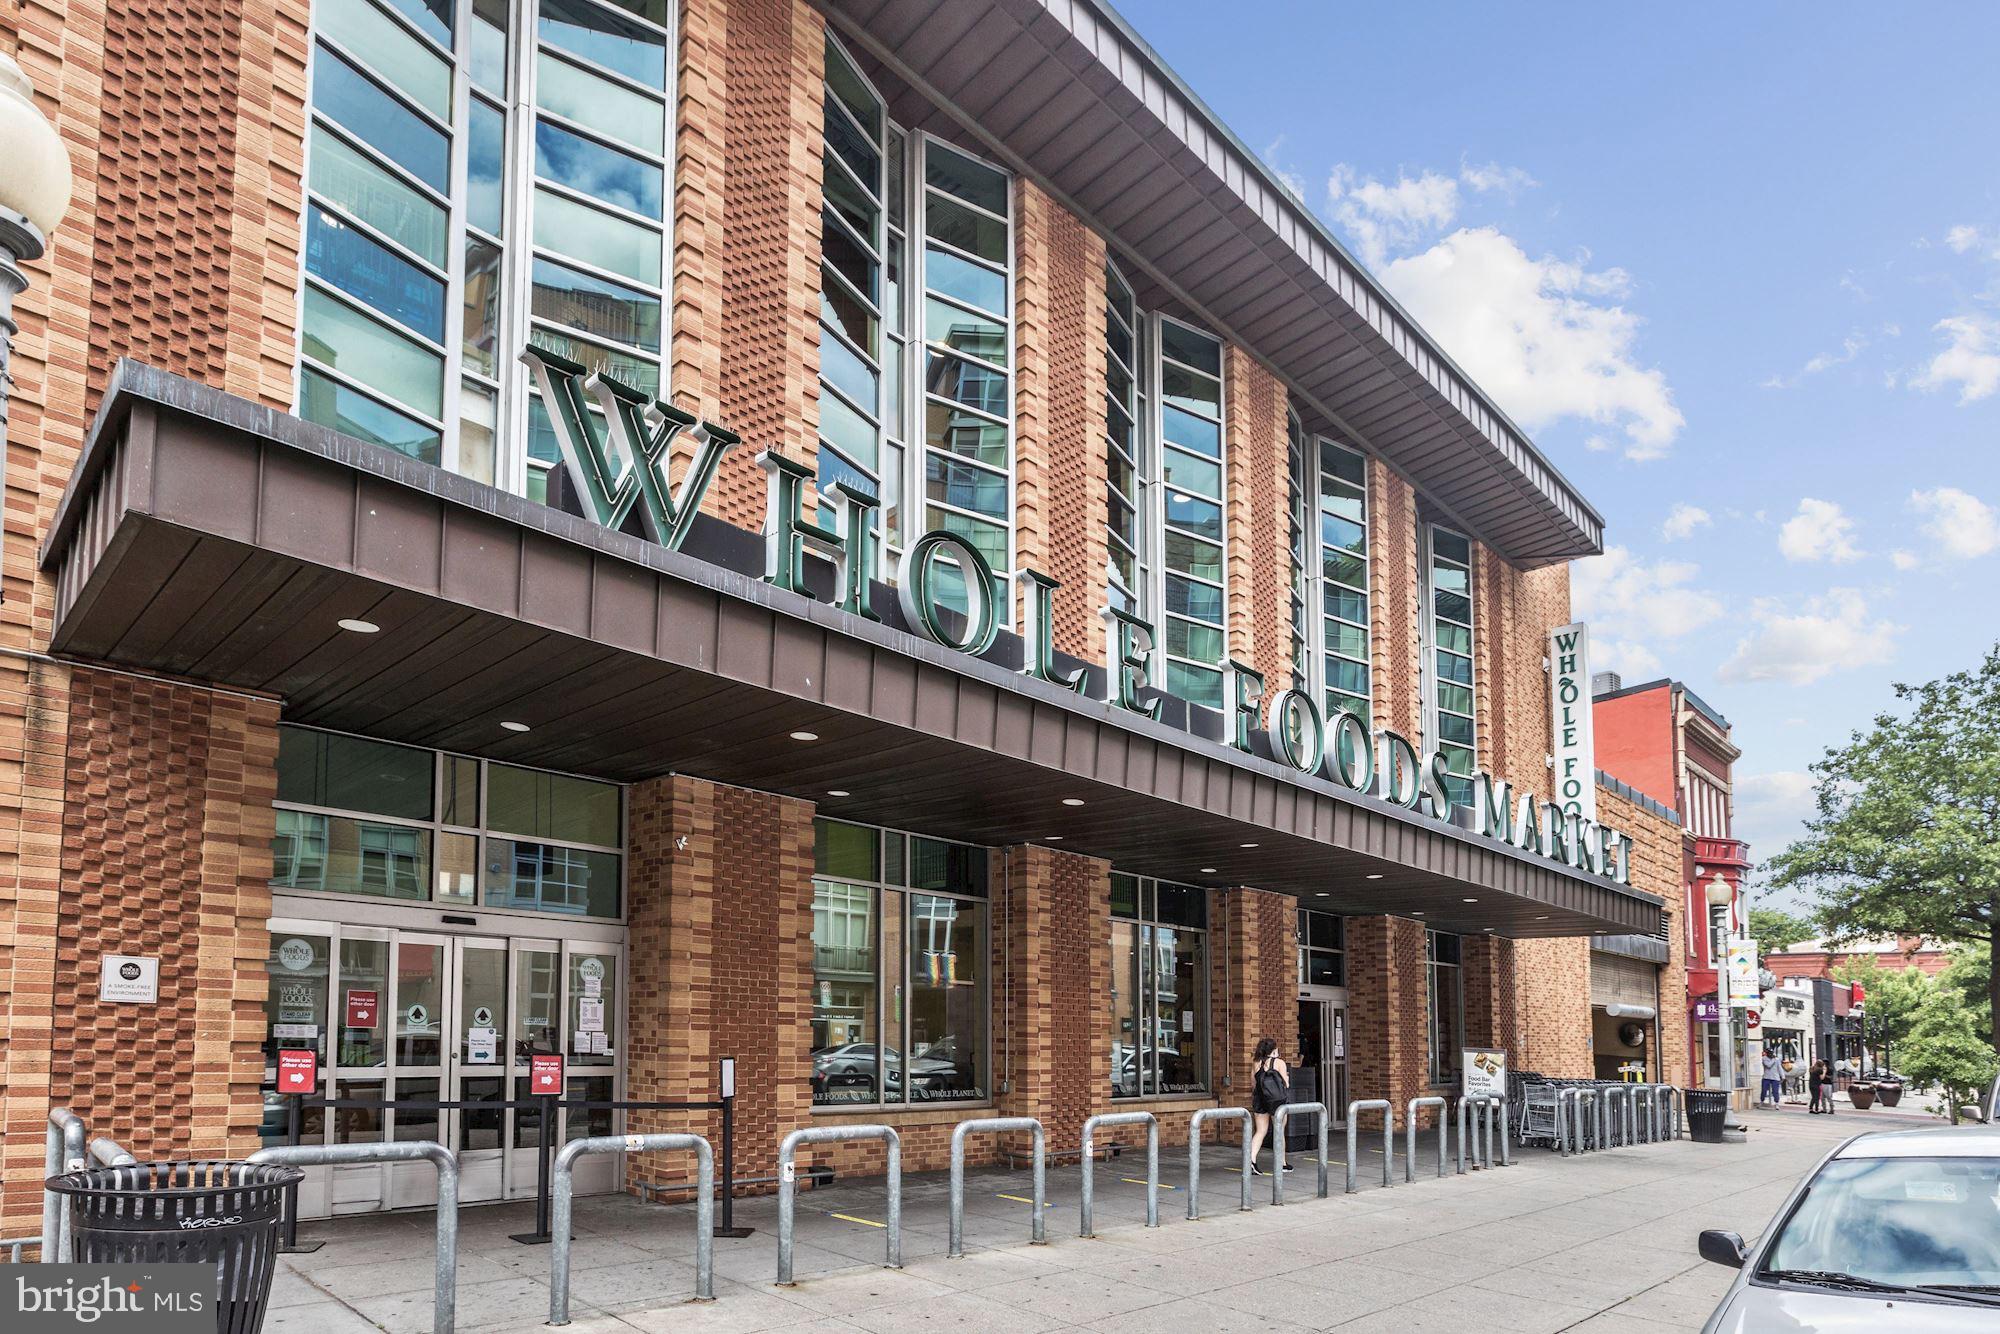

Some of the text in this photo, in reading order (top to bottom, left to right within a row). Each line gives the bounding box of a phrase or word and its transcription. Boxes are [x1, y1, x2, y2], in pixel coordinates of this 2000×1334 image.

[517, 342, 1633, 886] WHOLE FOODS MARKET
[1554, 631, 1579, 748] WHOLE
[282, 945, 310, 954] WHOLE
[279, 984, 315, 995] WHOLE
[929, 1088, 952, 1098] WHOLE
